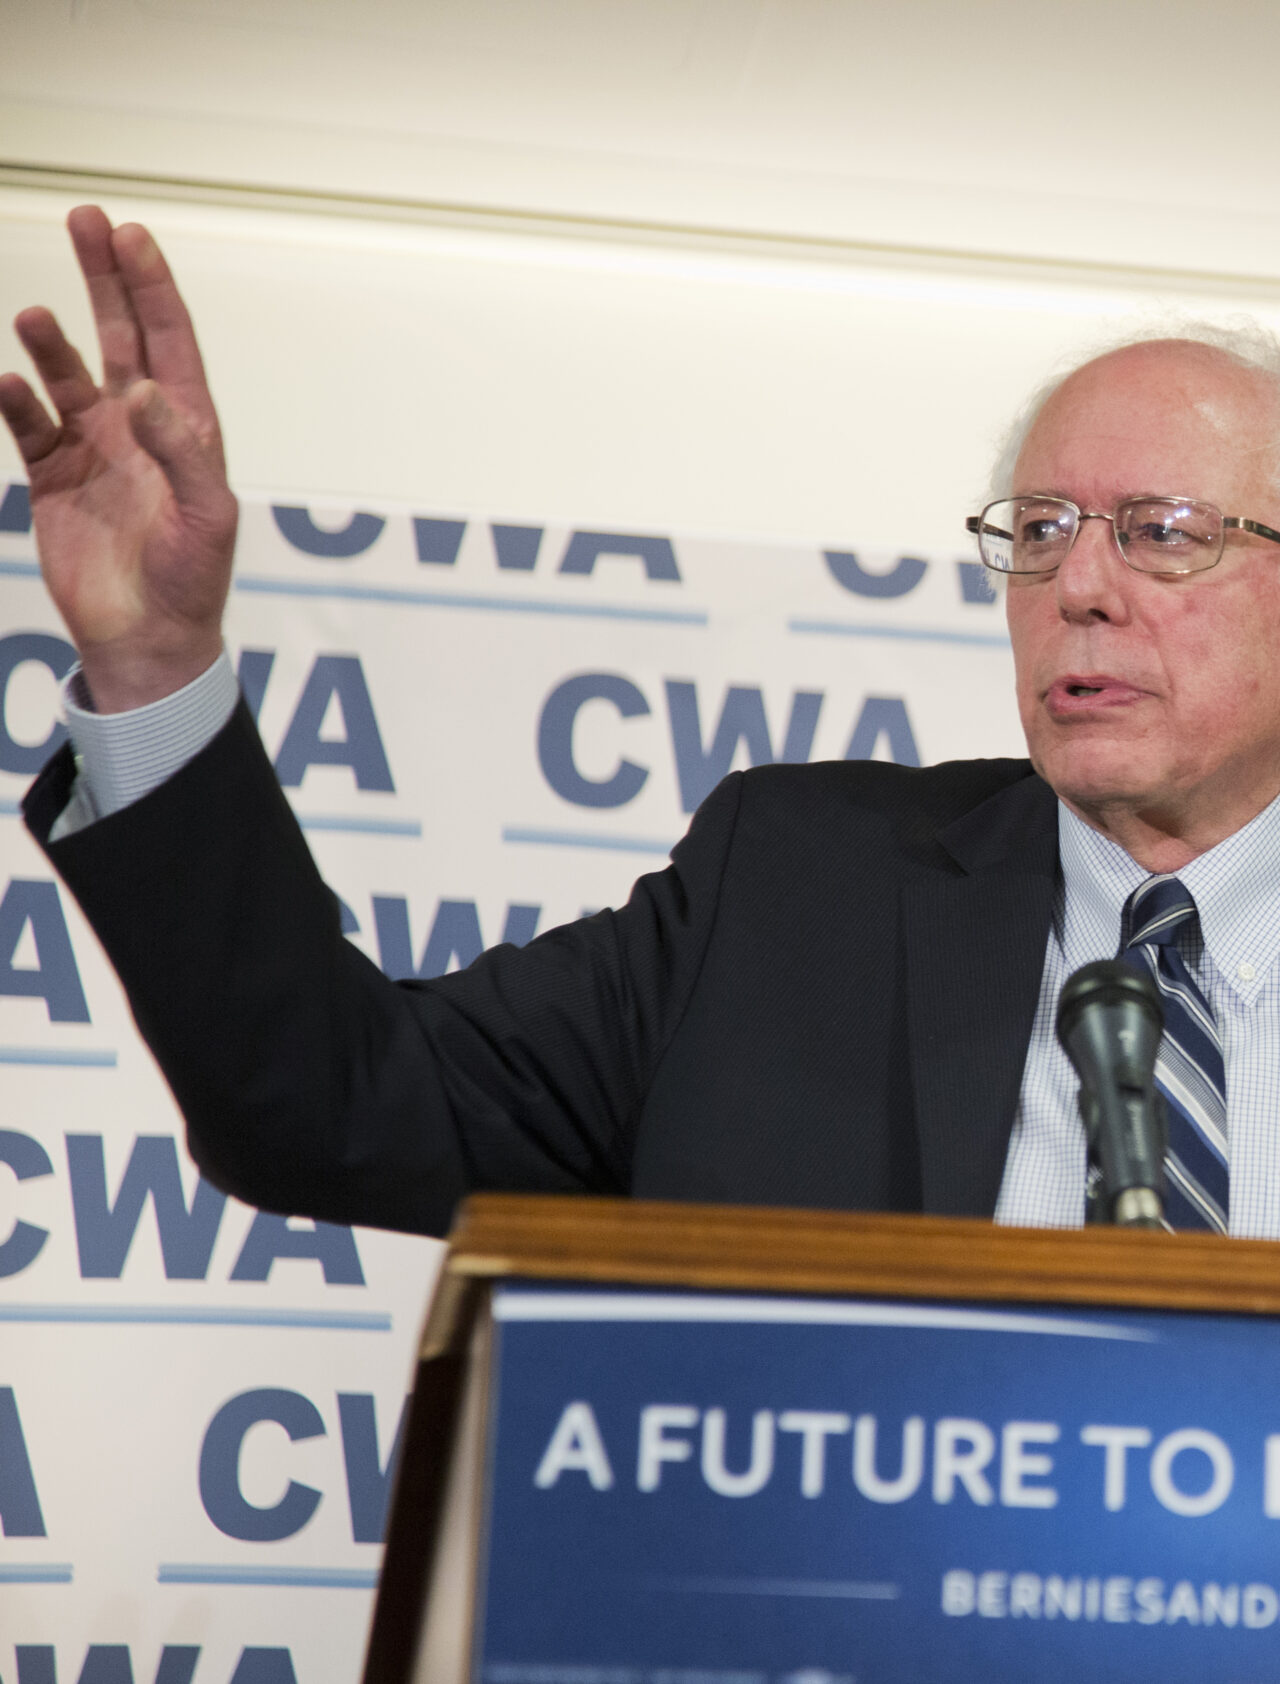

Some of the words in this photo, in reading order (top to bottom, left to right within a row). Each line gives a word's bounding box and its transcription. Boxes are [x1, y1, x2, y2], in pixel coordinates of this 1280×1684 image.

[534, 1402, 614, 1491] A
[637, 1406, 1061, 1510] FUTURE
[1080, 1424, 1235, 1518] TO
